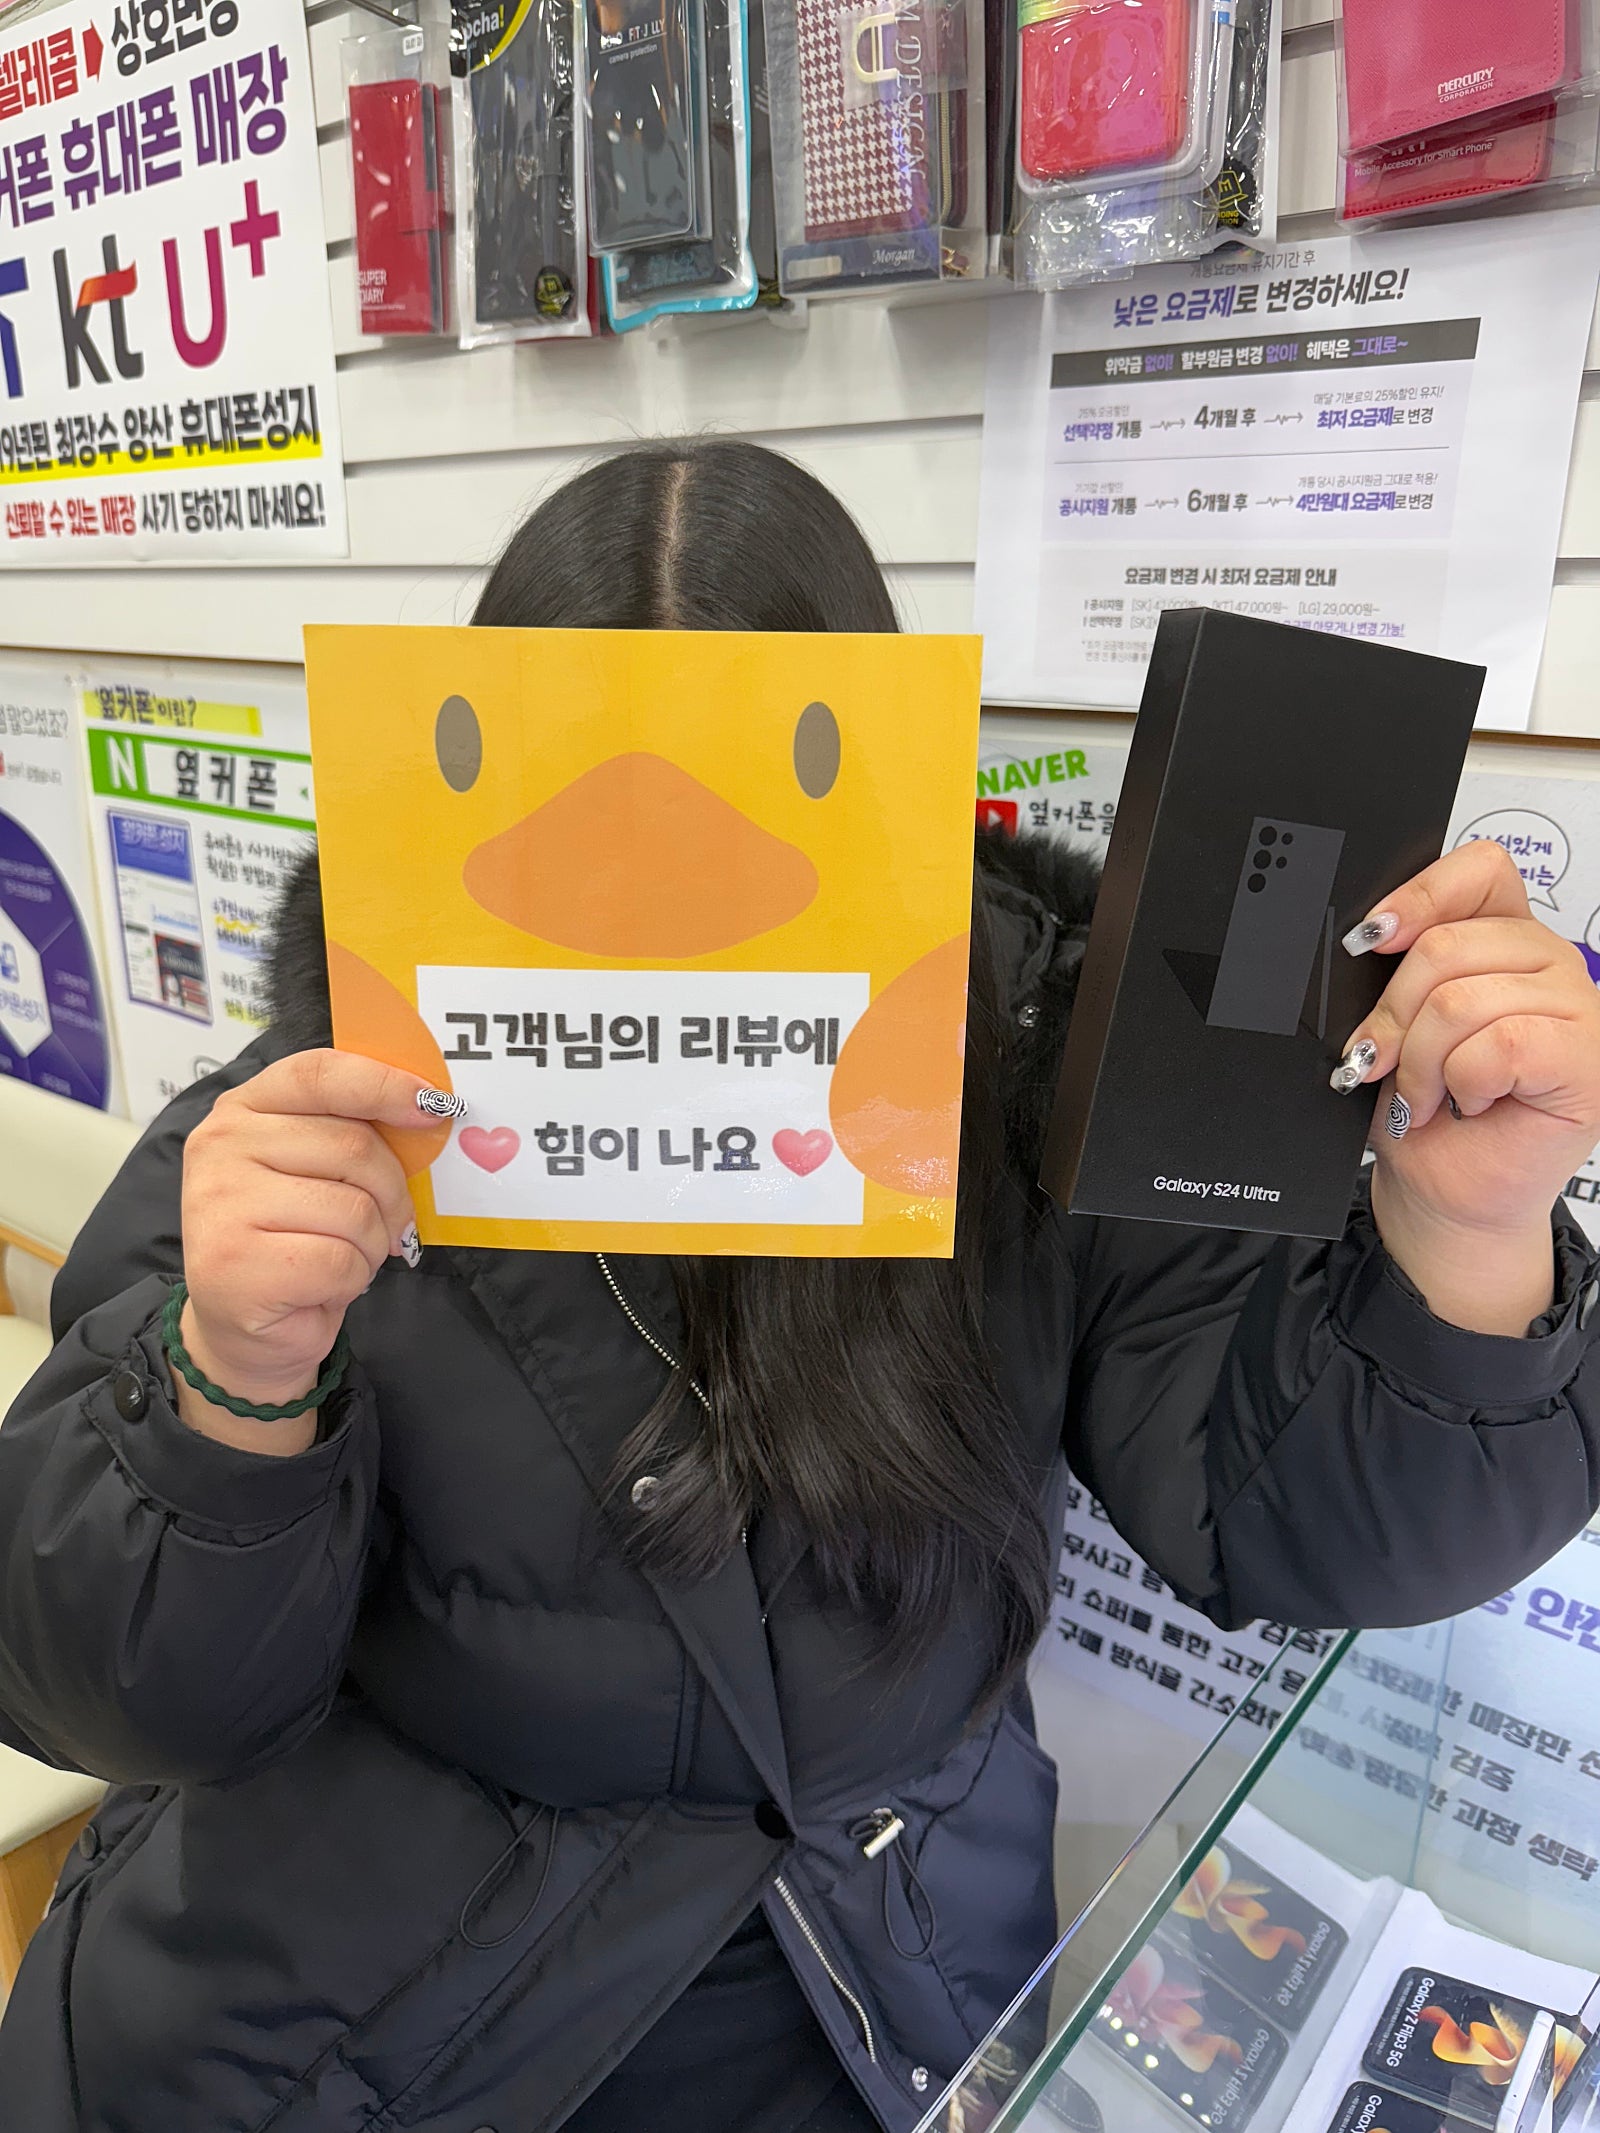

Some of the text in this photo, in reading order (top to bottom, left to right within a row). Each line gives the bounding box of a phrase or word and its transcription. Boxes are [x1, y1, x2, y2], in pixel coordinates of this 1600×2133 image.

[1437, 66, 1494, 96] MERCURY
[1439, 81, 1494, 104] CORPORATION
[61, 86, 182, 211] 휴대폰
[190, 44, 289, 166] 매장
[1354, 164, 1381, 177] Mobile
[1382, 156, 1421, 172] Accessory
[1422, 152, 1436, 166] for
[1437, 147, 1463, 161] Smart
[1465, 141, 1493, 155] Phone
[872, 247, 916, 266] Morgan
[1303, 249, 1316, 266] 후
[358, 268, 387, 286] SUPER
[360, 287, 385, 304] DIARY
[1113, 268, 1409, 328] 낮은 요금제로 변경하세요!
[53, 234, 145, 389] kt
[1105, 355, 1143, 376] 위약금
[1145, 353, 1174, 373] 없이!
[1181, 348, 1234, 370] 할부원금
[1235, 345, 1264, 366] 변경
[1266, 343, 1299, 364] 없이!
[1306, 339, 1351, 360] 혜택은
[1419, 385, 1444, 400] 유지!
[1115, 420, 1142, 439] 개통
[1193, 405, 1256, 430] 4개월 후
[1316, 406, 1434, 429] 최저 요금제로 변경
[55, 413, 121, 469] 최장수
[123, 404, 175, 463] 양산
[1384, 473, 1413, 486] 그대로
[5, 482, 327, 539] 신뢰할 수 있는 매장 사기 당하지 마세요!
[1111, 497, 1137, 516] 개통
[1186, 489, 1248, 513] 6개월 후
[1296, 491, 1434, 512] 4만원대 요금제로 변경
[1124, 567, 1338, 587] 요금제 변경 시 최저 요금제 안내
[1298, 601, 1321, 617] [LG]
[1356, 621, 1379, 637] 변경
[1380, 622, 1405, 637] 가능!
[977, 749, 1090, 797] NAVER
[443, 1011, 840, 1069] 고객님의 리뷰에
[534, 1120, 761, 1177] 힘이 나요
[1153, 1175, 1281, 1203] Galaxy S24 Ultra
[1063, 1532, 1132, 1579] 무사고
[1109, 1641, 1183, 1692] 방식을
[1467, 1701, 1572, 1764] 매장만
[1449, 1743, 1515, 1793] 검증
[1452, 1797, 1600, 1883] 과정 생략
[1406, 1977, 1436, 2017] Galaxy
[1404, 2014, 1419, 2026] Z
[1393, 2023, 1416, 2051] Flip3
[1386, 2049, 1404, 2068] 5G
